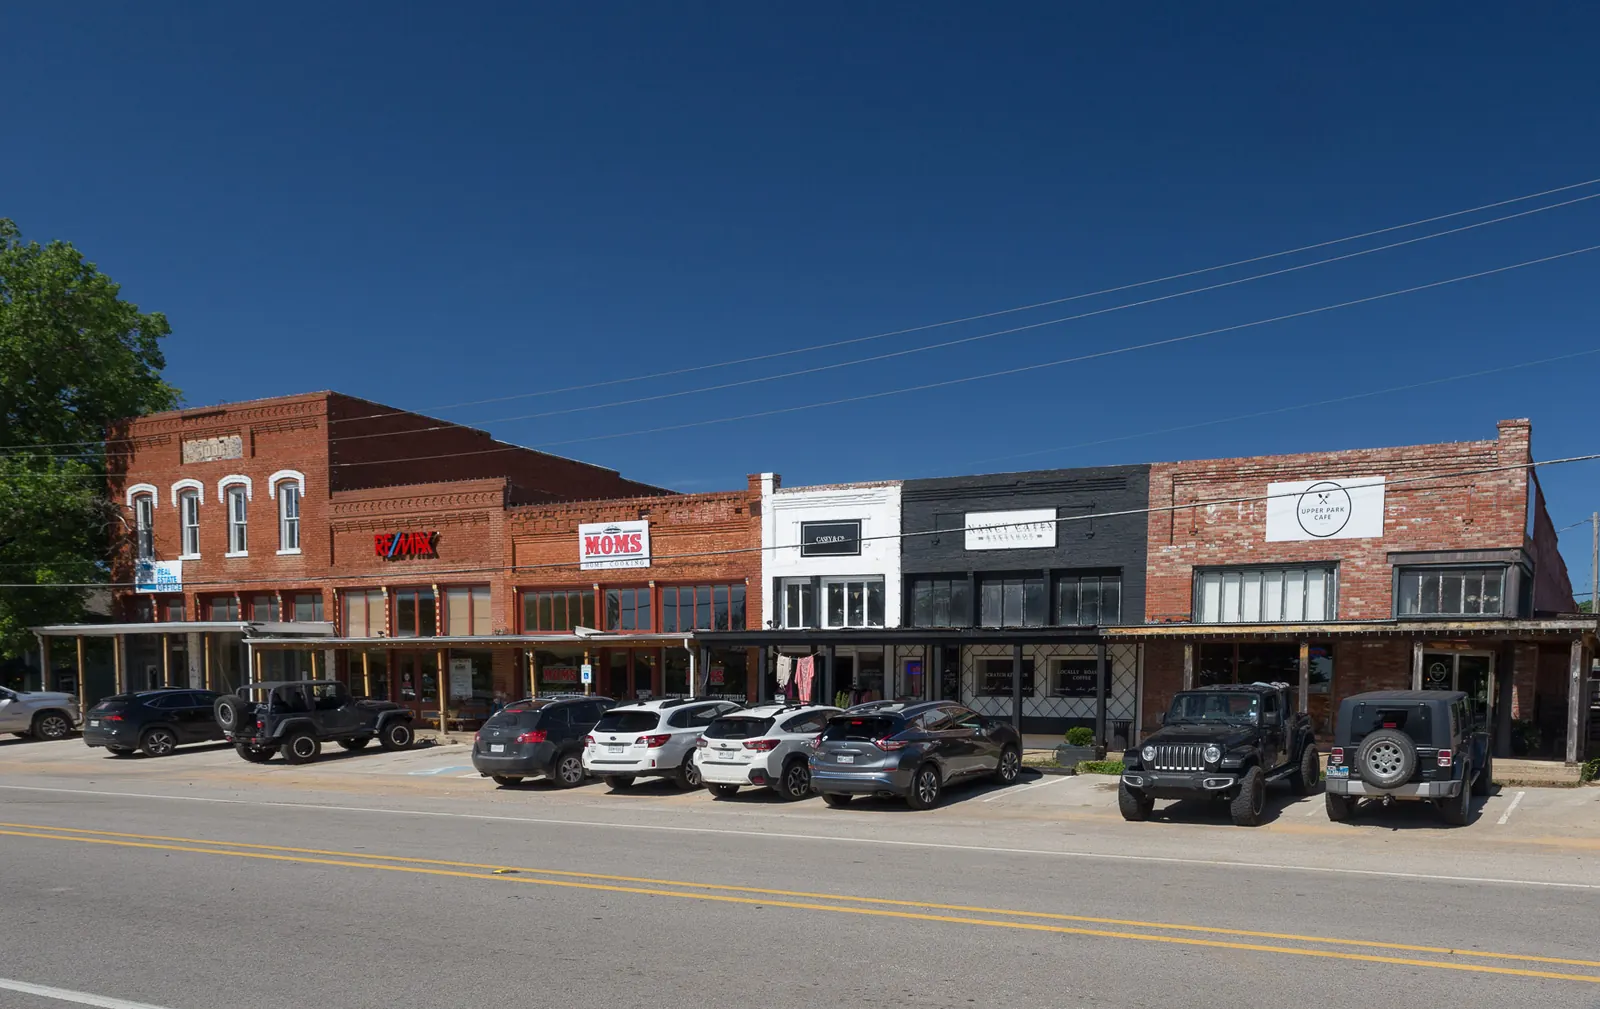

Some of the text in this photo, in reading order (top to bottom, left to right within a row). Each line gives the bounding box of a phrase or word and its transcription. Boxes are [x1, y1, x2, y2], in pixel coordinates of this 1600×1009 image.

[374, 531, 433, 557] RE/MAX
[585, 534, 642, 555] MOMS
[157, 576, 177, 584] ESTATE
[543, 669, 577, 680] MOMS
